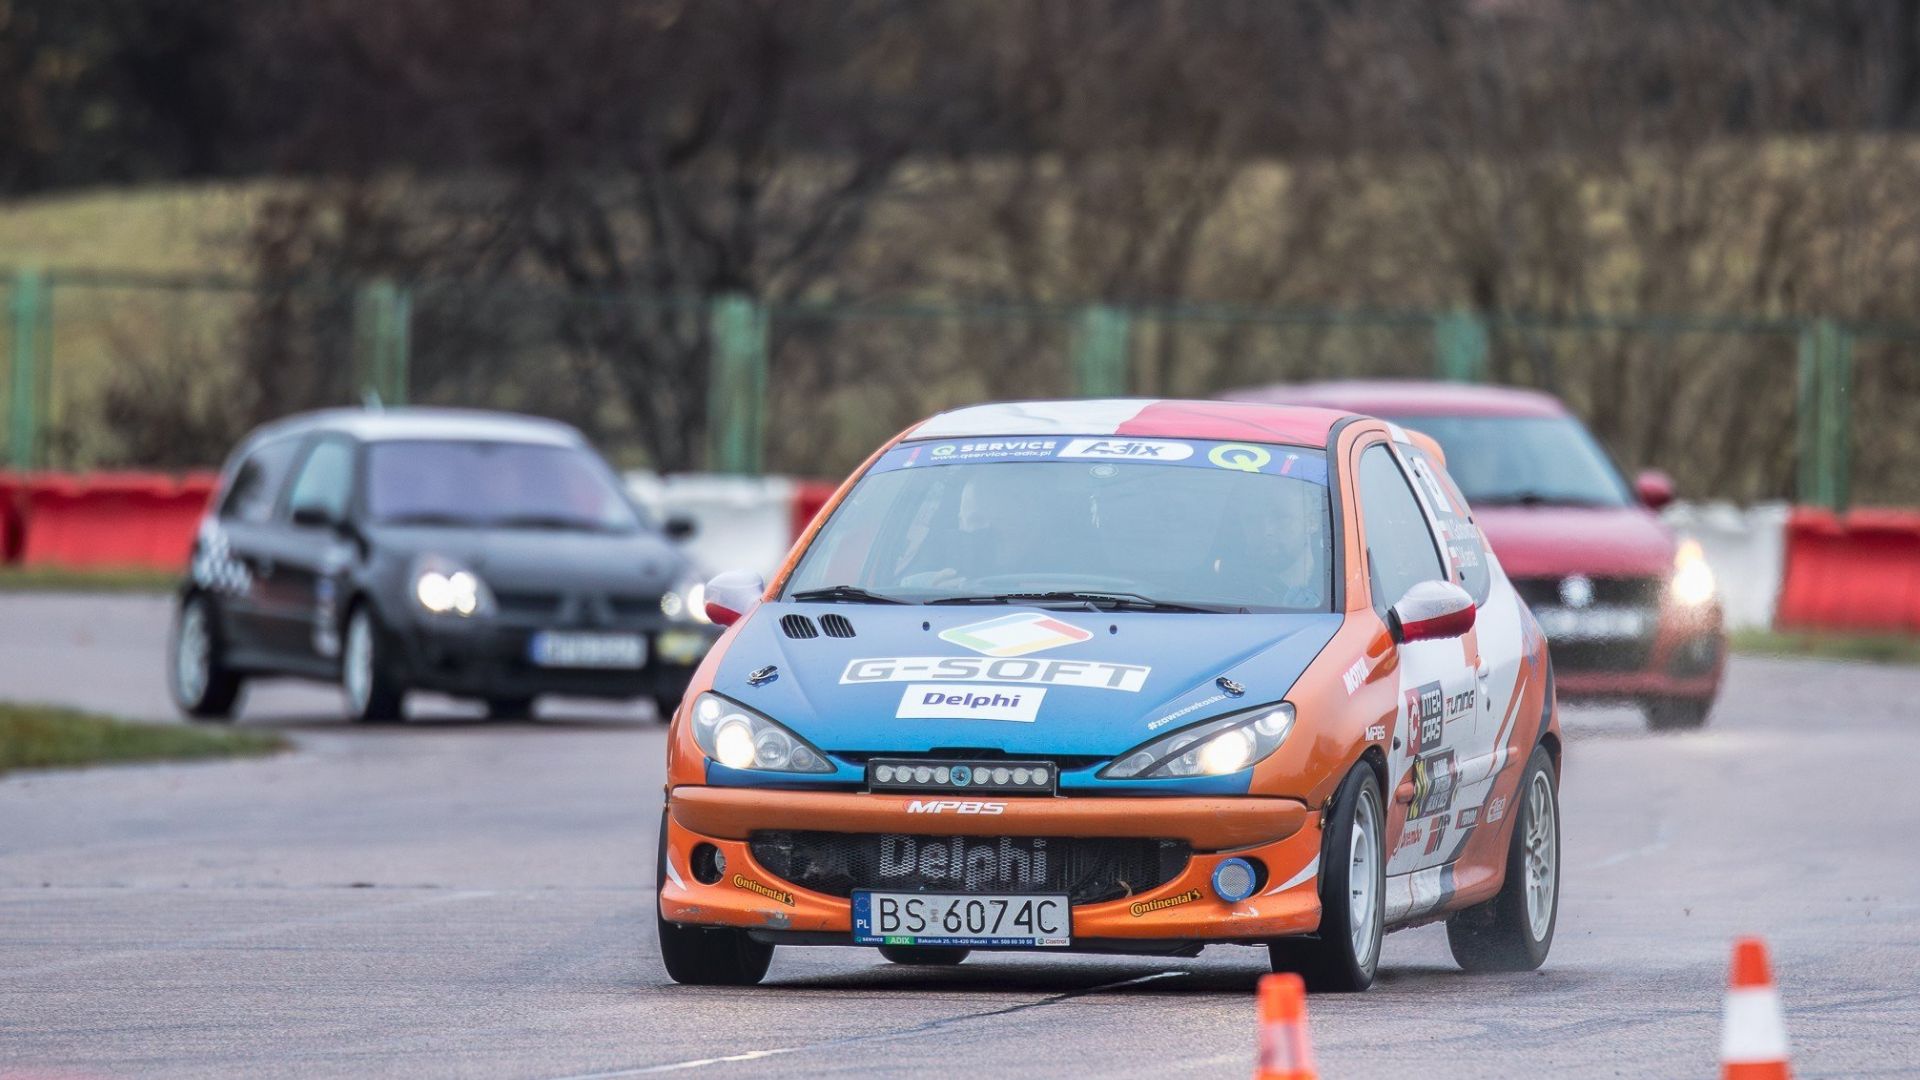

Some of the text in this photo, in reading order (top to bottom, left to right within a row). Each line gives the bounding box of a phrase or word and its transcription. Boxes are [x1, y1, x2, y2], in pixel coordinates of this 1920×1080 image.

[960, 441, 1057, 453] SERVICE
[1208, 444, 1271, 473] Q
[846, 658, 1147, 688] G-SOFT
[1342, 657, 1370, 696] MOTUL
[922, 692, 1022, 709] Delphi
[1446, 690, 1475, 717] TUNING
[1365, 725, 1386, 742] MPBS
[1421, 716, 1442, 744] CARS
[906, 800, 1009, 815] MPBS
[879, 834, 1048, 892] Delphi
[733, 873, 788, 904] Continental
[879, 897, 927, 934] BS
[942, 899, 1059, 935] 6074C
[1130, 893, 1193, 917] Continental
[856, 919, 870, 929] PL
[890, 936, 910, 944] ADIX
